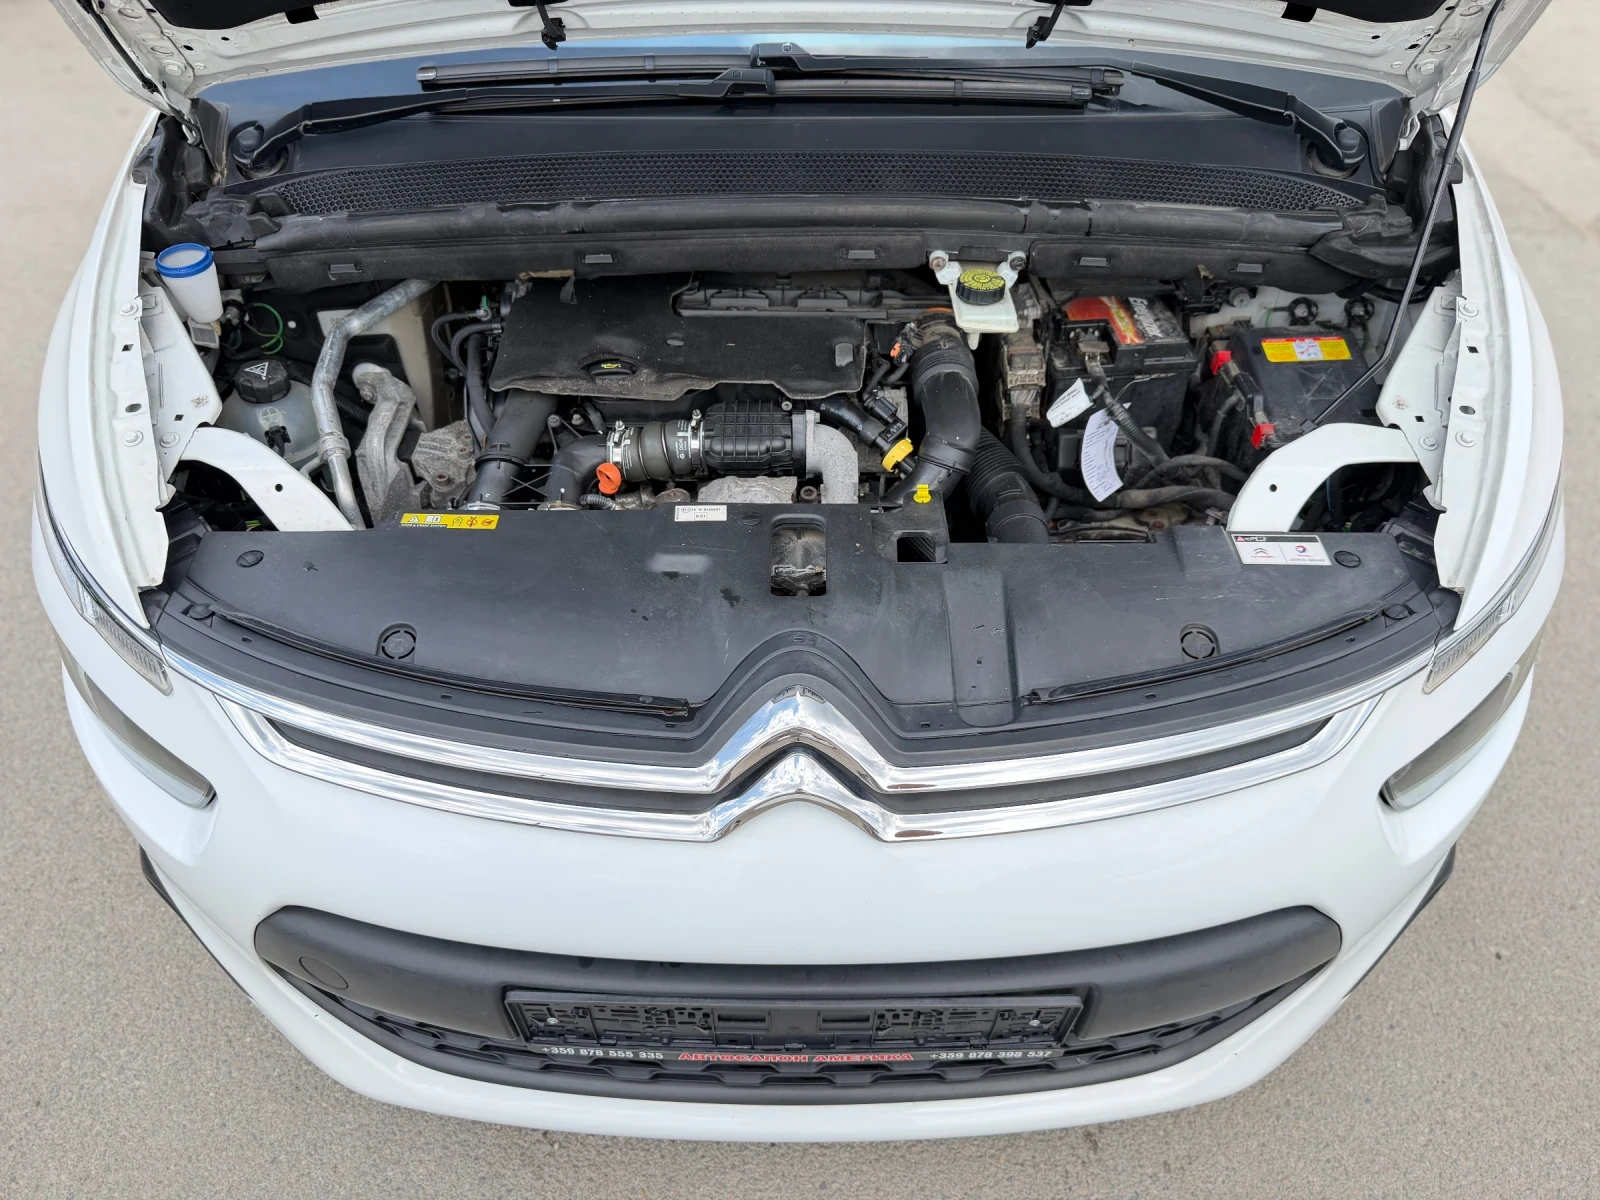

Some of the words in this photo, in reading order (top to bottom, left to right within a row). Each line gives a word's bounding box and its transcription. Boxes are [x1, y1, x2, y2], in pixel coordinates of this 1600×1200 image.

[1127, 297, 1163, 338] Energizer
[541, 1047, 575, 1055] +359
[579, 1048, 604, 1057] 878
[609, 1050, 634, 1058] 555
[639, 1051, 664, 1059] 335
[678, 1052, 808, 1063] АВТОСАЛОН
[813, 1053, 914, 1063] АМЕРИКА
[929, 1052, 964, 1060] +359
[968, 1051, 993, 1059] 878
[1027, 1050, 1053, 1058] 537
